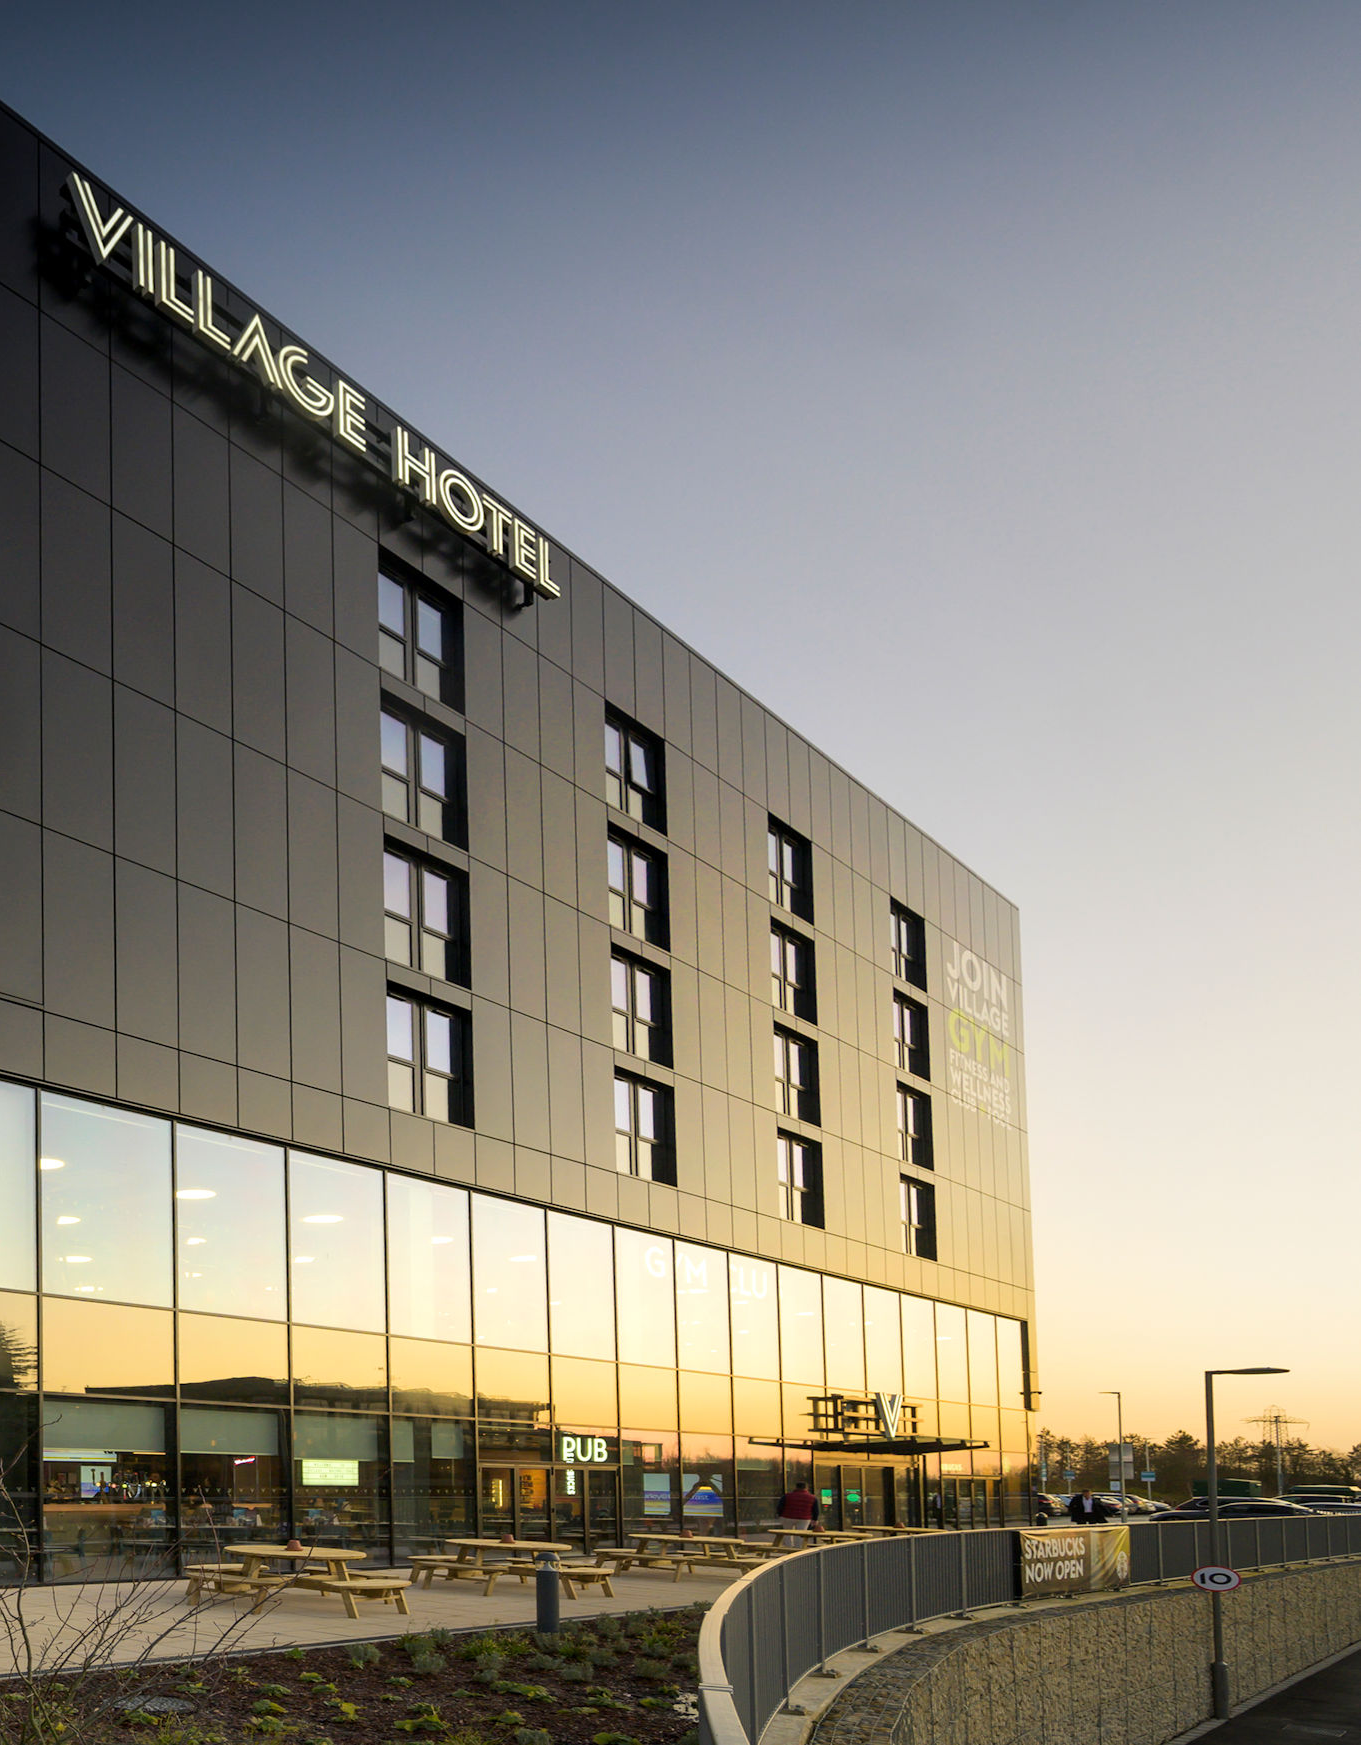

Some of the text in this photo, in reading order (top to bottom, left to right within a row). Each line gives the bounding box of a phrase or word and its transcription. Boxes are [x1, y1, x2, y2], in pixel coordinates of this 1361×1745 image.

[68, 171, 561, 600] VILLAGE HOTEL
[946, 940, 1008, 1012] JOIN
[947, 976, 1009, 1037] VILLAGE
[948, 1008, 1010, 1078] GYM
[949, 1048, 1010, 1094] FITNESS AND
[950, 1065, 1012, 1114] WELLNESS
[561, 1436, 608, 1463] PUB
[1024, 1536, 1086, 1560] STARBUCKS
[1025, 1558, 1084, 1584] NOW OPEN
[1199, 1572, 1232, 1585] 10
